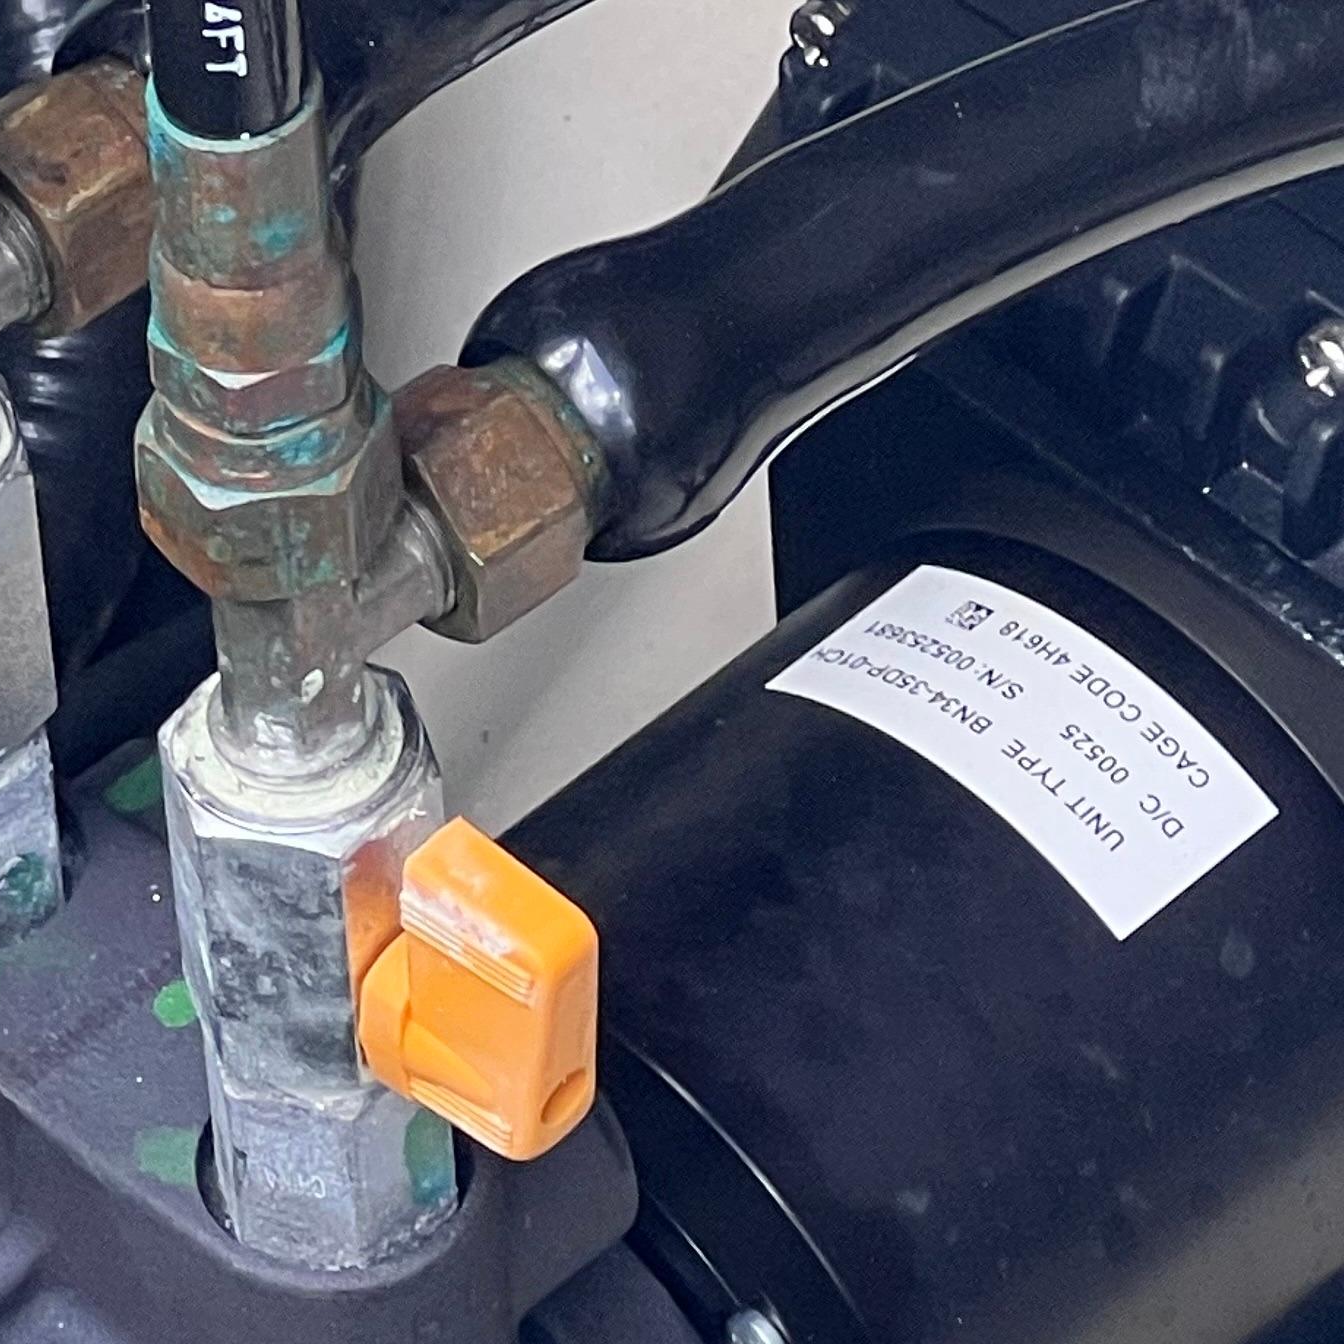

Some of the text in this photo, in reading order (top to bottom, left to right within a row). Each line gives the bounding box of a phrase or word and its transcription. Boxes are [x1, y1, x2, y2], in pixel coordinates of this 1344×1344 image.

[999, 620, 1210, 788] CAGE CODE 4H618
[1001, 738, 1066, 796] TYPE
[1059, 723, 1129, 784] 00525
[1065, 796, 1125, 852] UNIT
[1139, 793, 1184, 838] D/C
